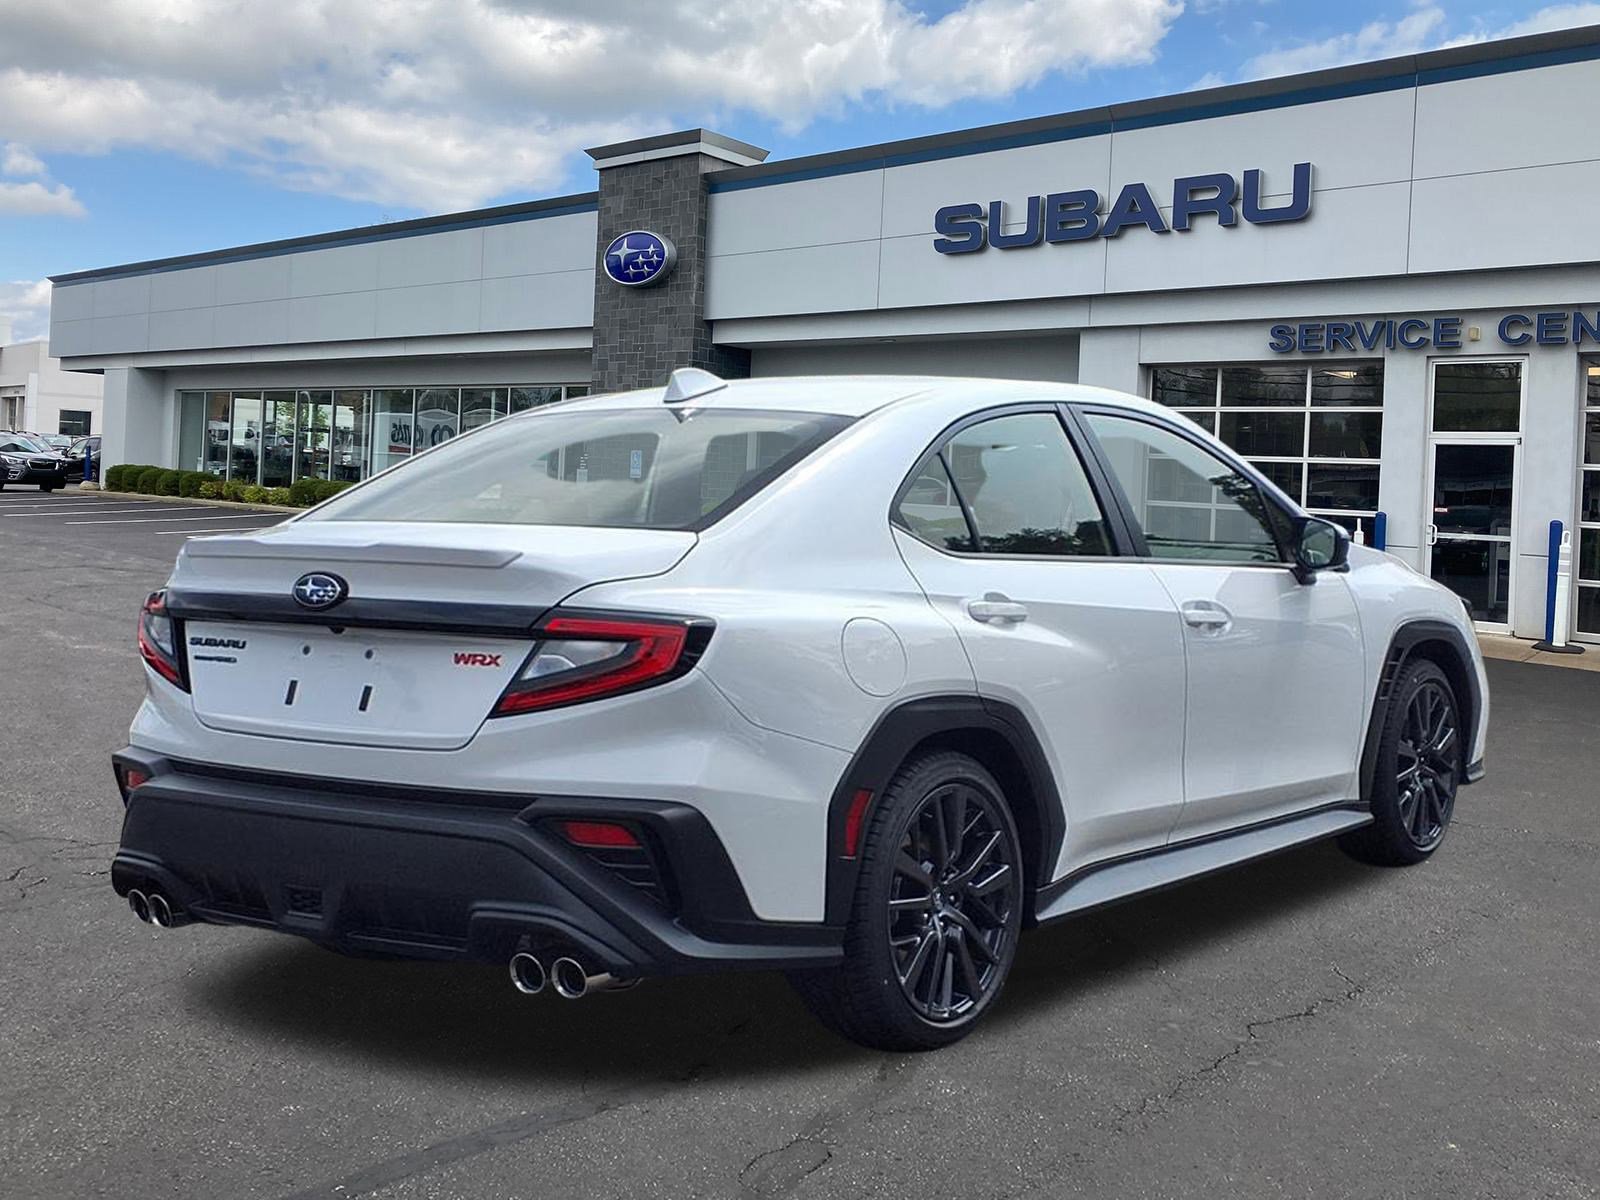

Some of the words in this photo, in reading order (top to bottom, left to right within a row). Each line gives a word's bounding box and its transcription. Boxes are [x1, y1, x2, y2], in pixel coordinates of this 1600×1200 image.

[934, 161, 1313, 255] SUBARU
[1269, 317, 1463, 353] SERVICE
[190, 636, 247, 650] SUBARU
[453, 652, 502, 667] WRX
